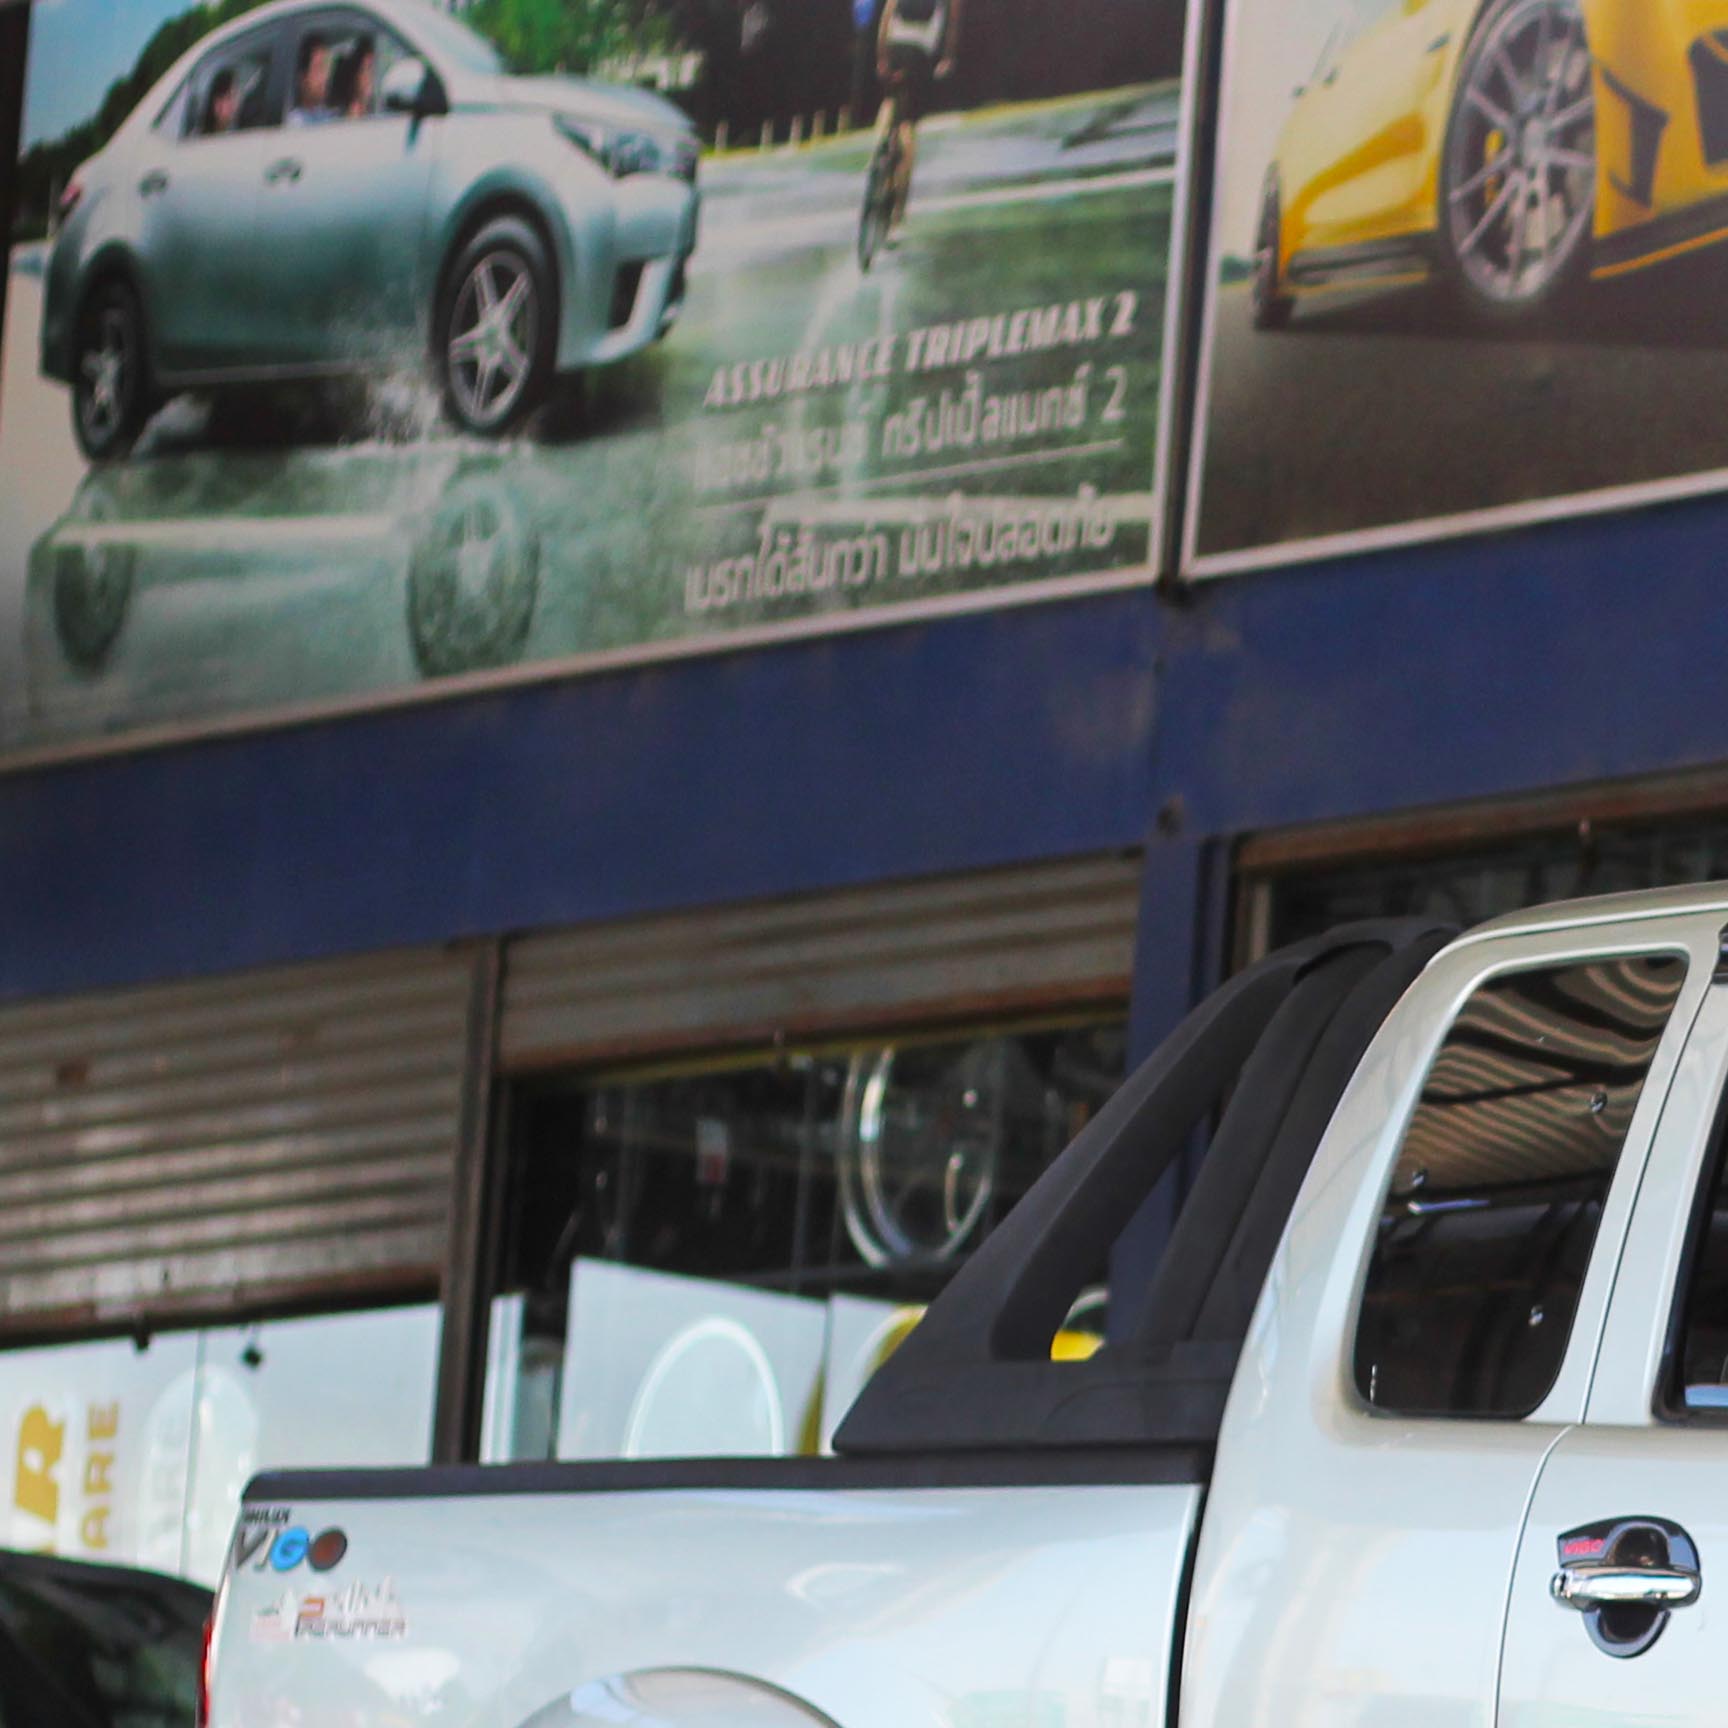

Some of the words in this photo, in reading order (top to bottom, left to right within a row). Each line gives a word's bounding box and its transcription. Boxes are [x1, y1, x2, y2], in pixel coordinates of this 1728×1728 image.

[702, 336, 898, 408] ASSURANCE
[905, 299, 1107, 373] TRIPLEMAX
[1108, 290, 1138, 337] 2
[1101, 365, 1128, 422] 2
